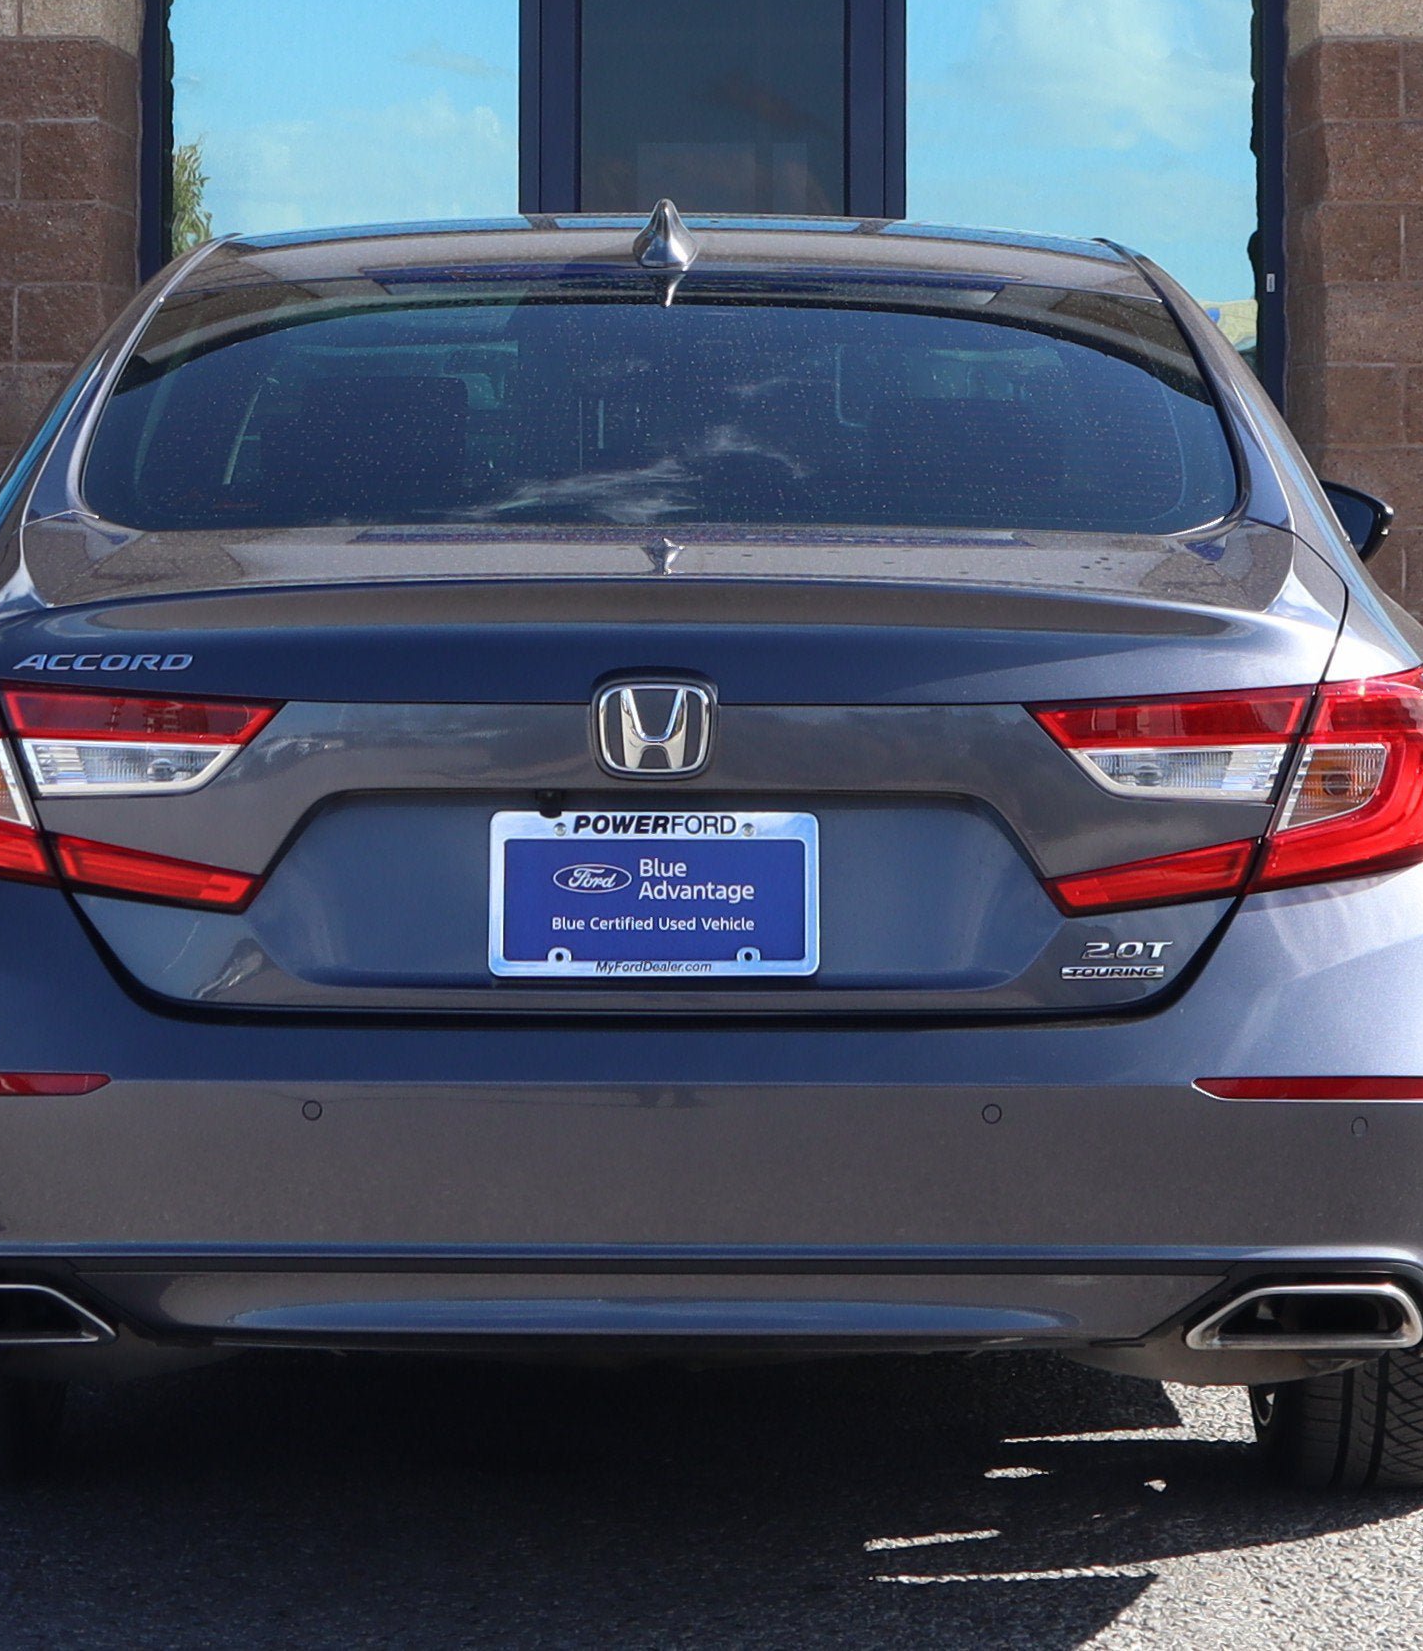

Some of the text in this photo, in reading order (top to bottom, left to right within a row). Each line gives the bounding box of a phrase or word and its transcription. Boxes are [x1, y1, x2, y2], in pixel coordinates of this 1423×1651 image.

[12, 653, 194, 672] ACCORD
[638, 858, 688, 878] Blue
[568, 867, 618, 889] Ford
[638, 881, 755, 904] Advantage
[551, 916, 755, 931] Blue Certified Used Vehicle
[1081, 941, 1174, 961] 2.0T
[594, 960, 713, 975] MyFordDealer.com
[1067, 967, 1158, 978] TOURING
